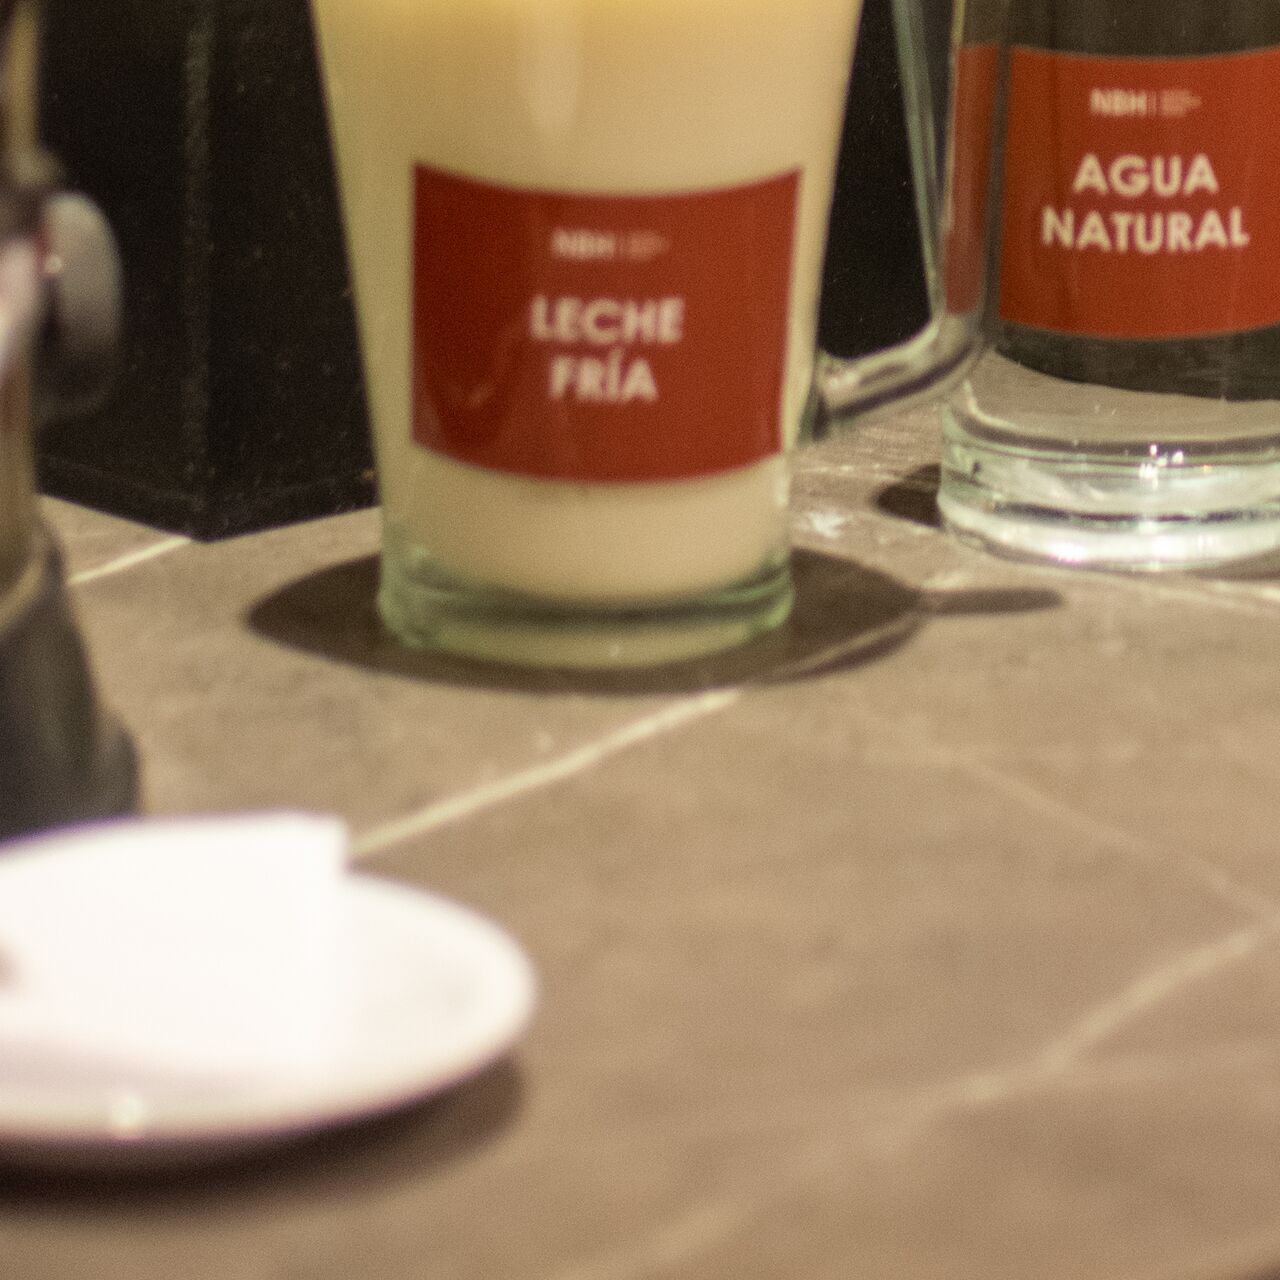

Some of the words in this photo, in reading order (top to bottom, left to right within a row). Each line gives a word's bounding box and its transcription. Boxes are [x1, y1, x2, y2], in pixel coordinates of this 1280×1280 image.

[1090, 88, 1147, 116] NBH
[1072, 152, 1219, 197] AGUA
[1041, 204, 1250, 254] NATURAL
[529, 293, 684, 346] LECHE
[550, 345, 659, 403] FRÍA
